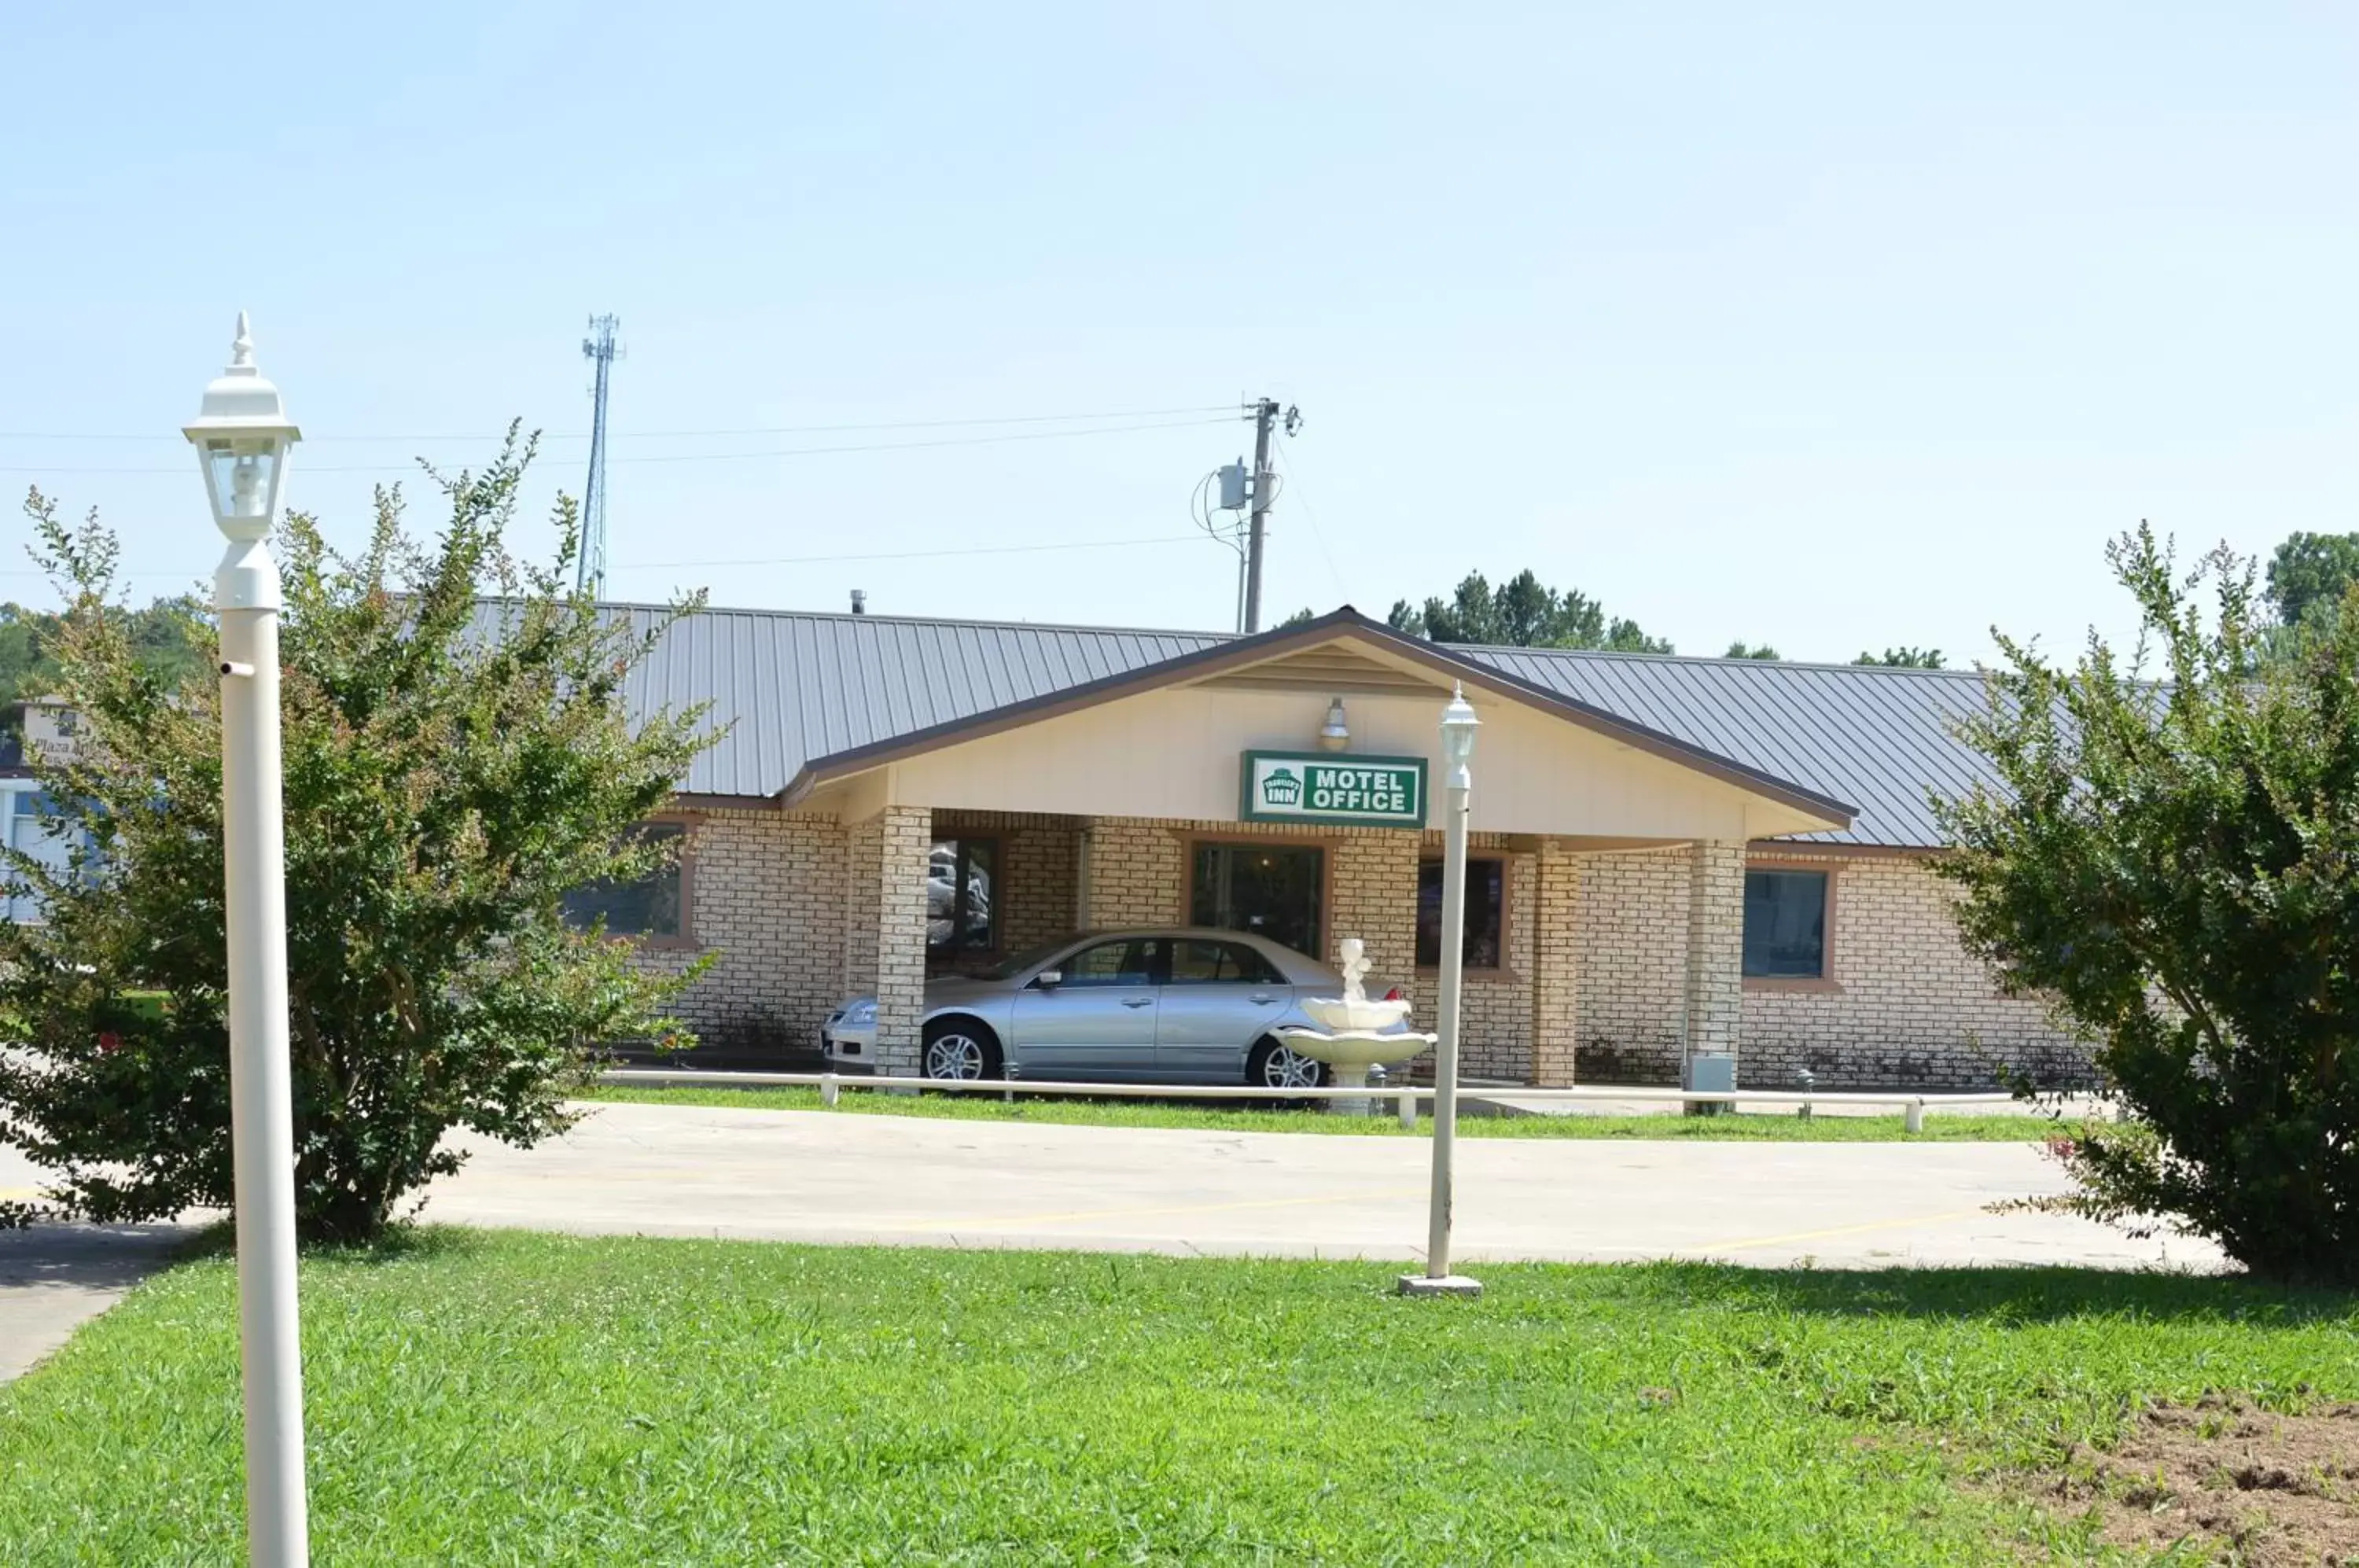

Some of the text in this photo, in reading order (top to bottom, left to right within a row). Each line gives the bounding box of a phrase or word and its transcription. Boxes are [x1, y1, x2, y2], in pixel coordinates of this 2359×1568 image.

[1316, 770, 1404, 790] MOTEL
[1268, 788, 1295, 802] INN
[1313, 790, 1405, 811] OFFICE
